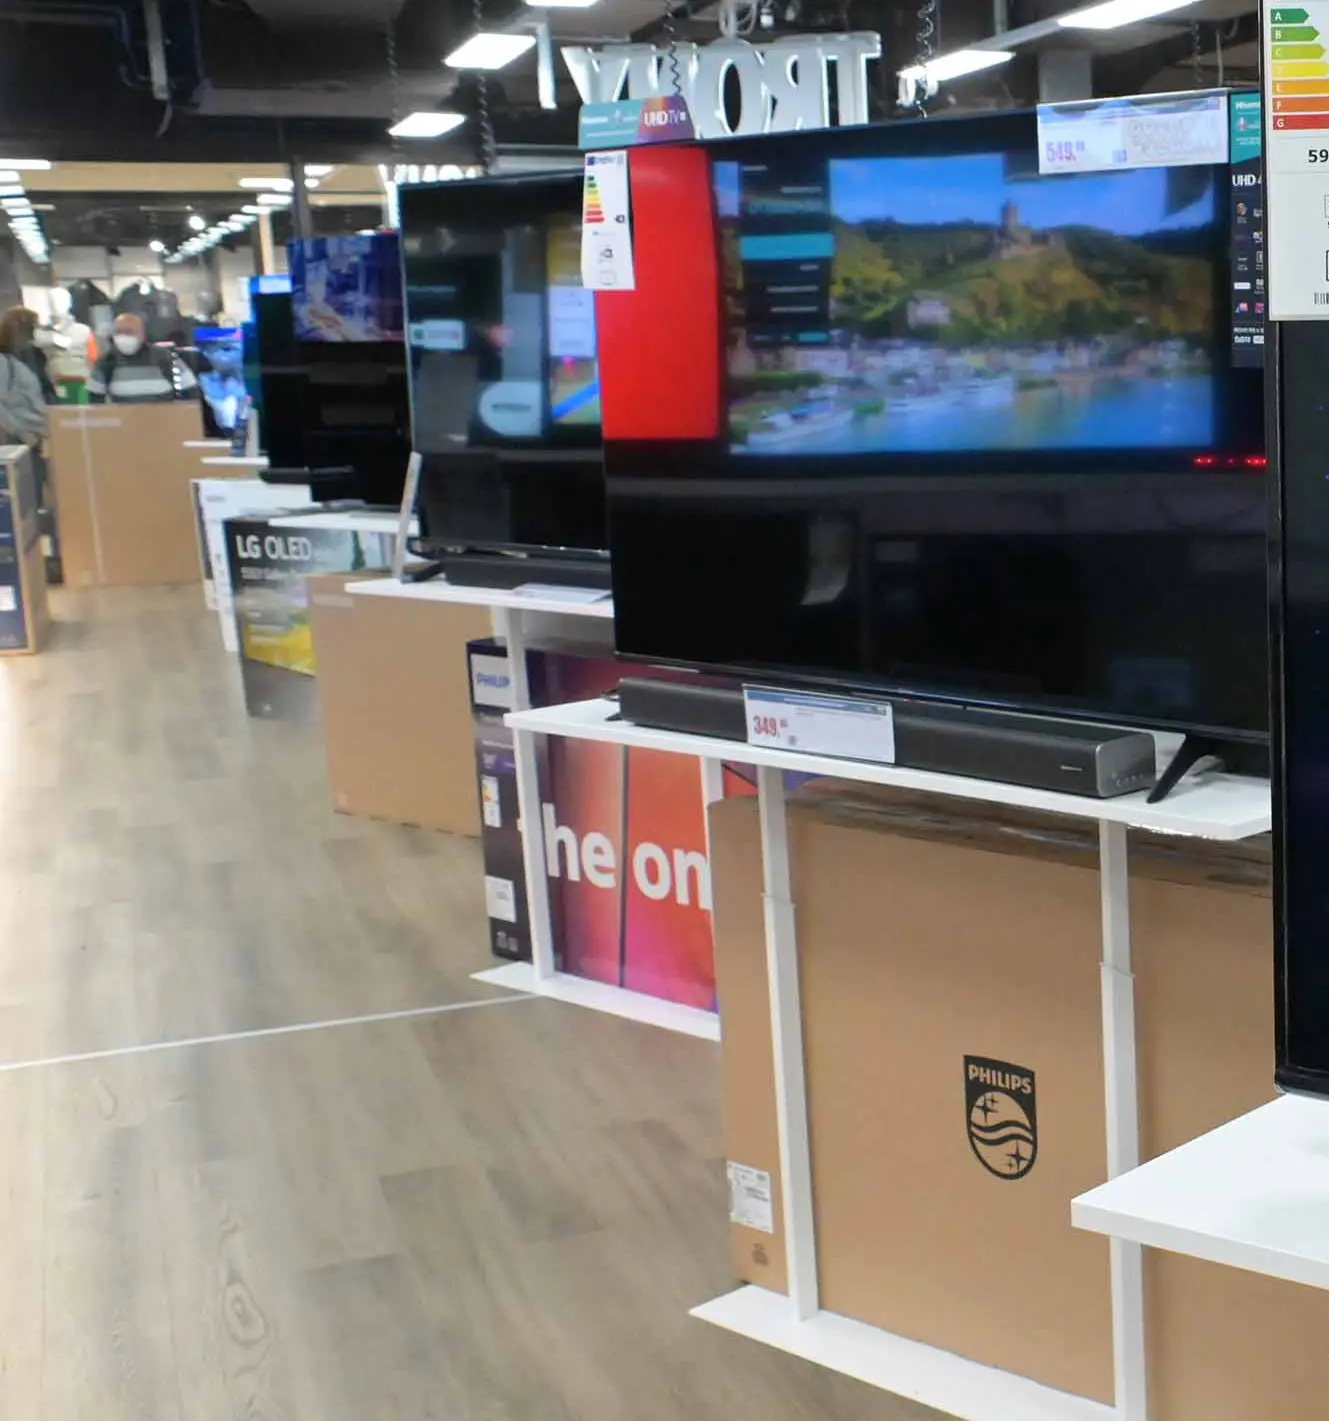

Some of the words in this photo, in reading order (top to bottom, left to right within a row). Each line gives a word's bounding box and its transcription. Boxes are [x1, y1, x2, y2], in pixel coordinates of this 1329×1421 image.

[1275, 12, 1282, 21] A
[1275, 30, 1282, 39] B
[1277, 119, 1284, 128] G
[1308, 149, 1329, 162] 59
[1232, 175, 1256, 186] UHD
[236, 535, 262, 559] LG
[265, 537, 313, 561] OLED
[542, 803, 617, 889] he
[633, 842, 713, 911] on
[968, 1064, 1032, 1095] PHILIPS
